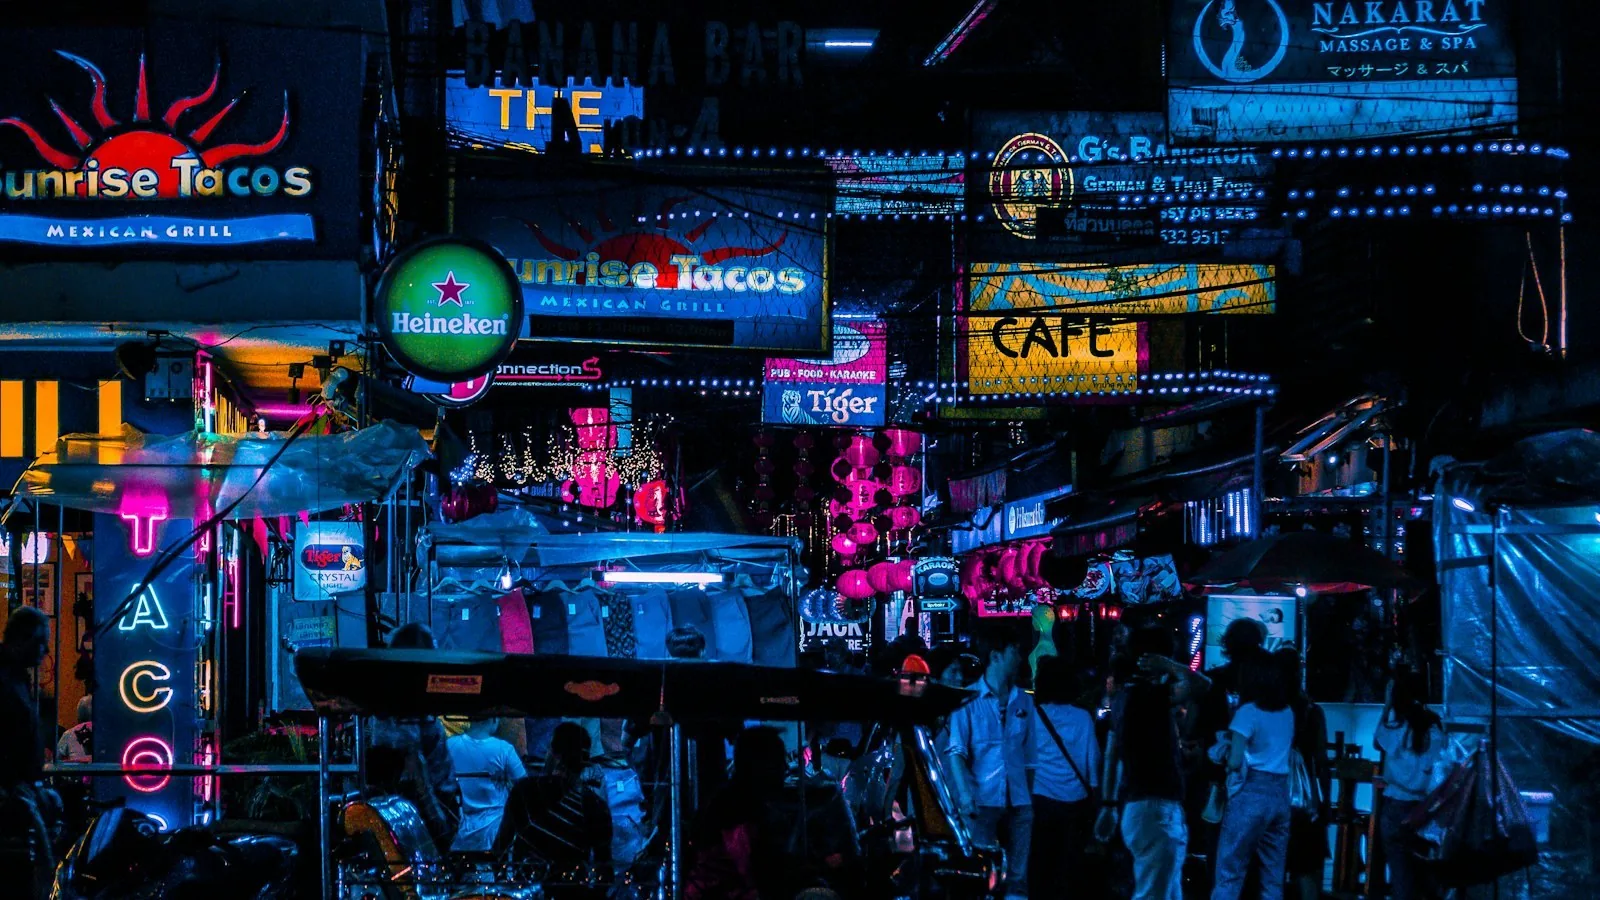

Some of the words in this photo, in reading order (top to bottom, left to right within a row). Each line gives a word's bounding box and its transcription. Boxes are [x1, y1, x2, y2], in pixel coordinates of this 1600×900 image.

[1312, 0, 1486, 25] NAKARAT
[704, 20, 803, 87] BAR
[1320, 38, 1411, 53] MASSAGE
[1420, 38, 1433, 50] &
[1441, 37, 1477, 49] SPA
[1327, 62, 1409, 78] マッサージ
[1416, 63, 1429, 75] &
[489, 89, 602, 131] THE
[1129, 136, 1258, 165] BANGKOK
[171, 151, 312, 198] Tacos
[1083, 175, 1146, 192] GERMAN
[47, 225, 157, 238] MEXICAN
[166, 224, 232, 238] GRILL
[508, 252, 659, 289] unrise
[670, 254, 807, 295] Tacos
[540, 295, 647, 310] MEXICAN
[661, 299, 725, 313] GRILL
[392, 313, 508, 335] Heineken
[992, 317, 1115, 358] CAFE
[770, 369, 791, 378] PUB
[798, 370, 823, 378] FOOD
[830, 371, 876, 380] KARAOKE
[807, 388, 878, 423] Tiger
[305, 549, 341, 569] Tiger
[310, 573, 358, 582] CRYSTAL
[806, 622, 863, 637] JACK
